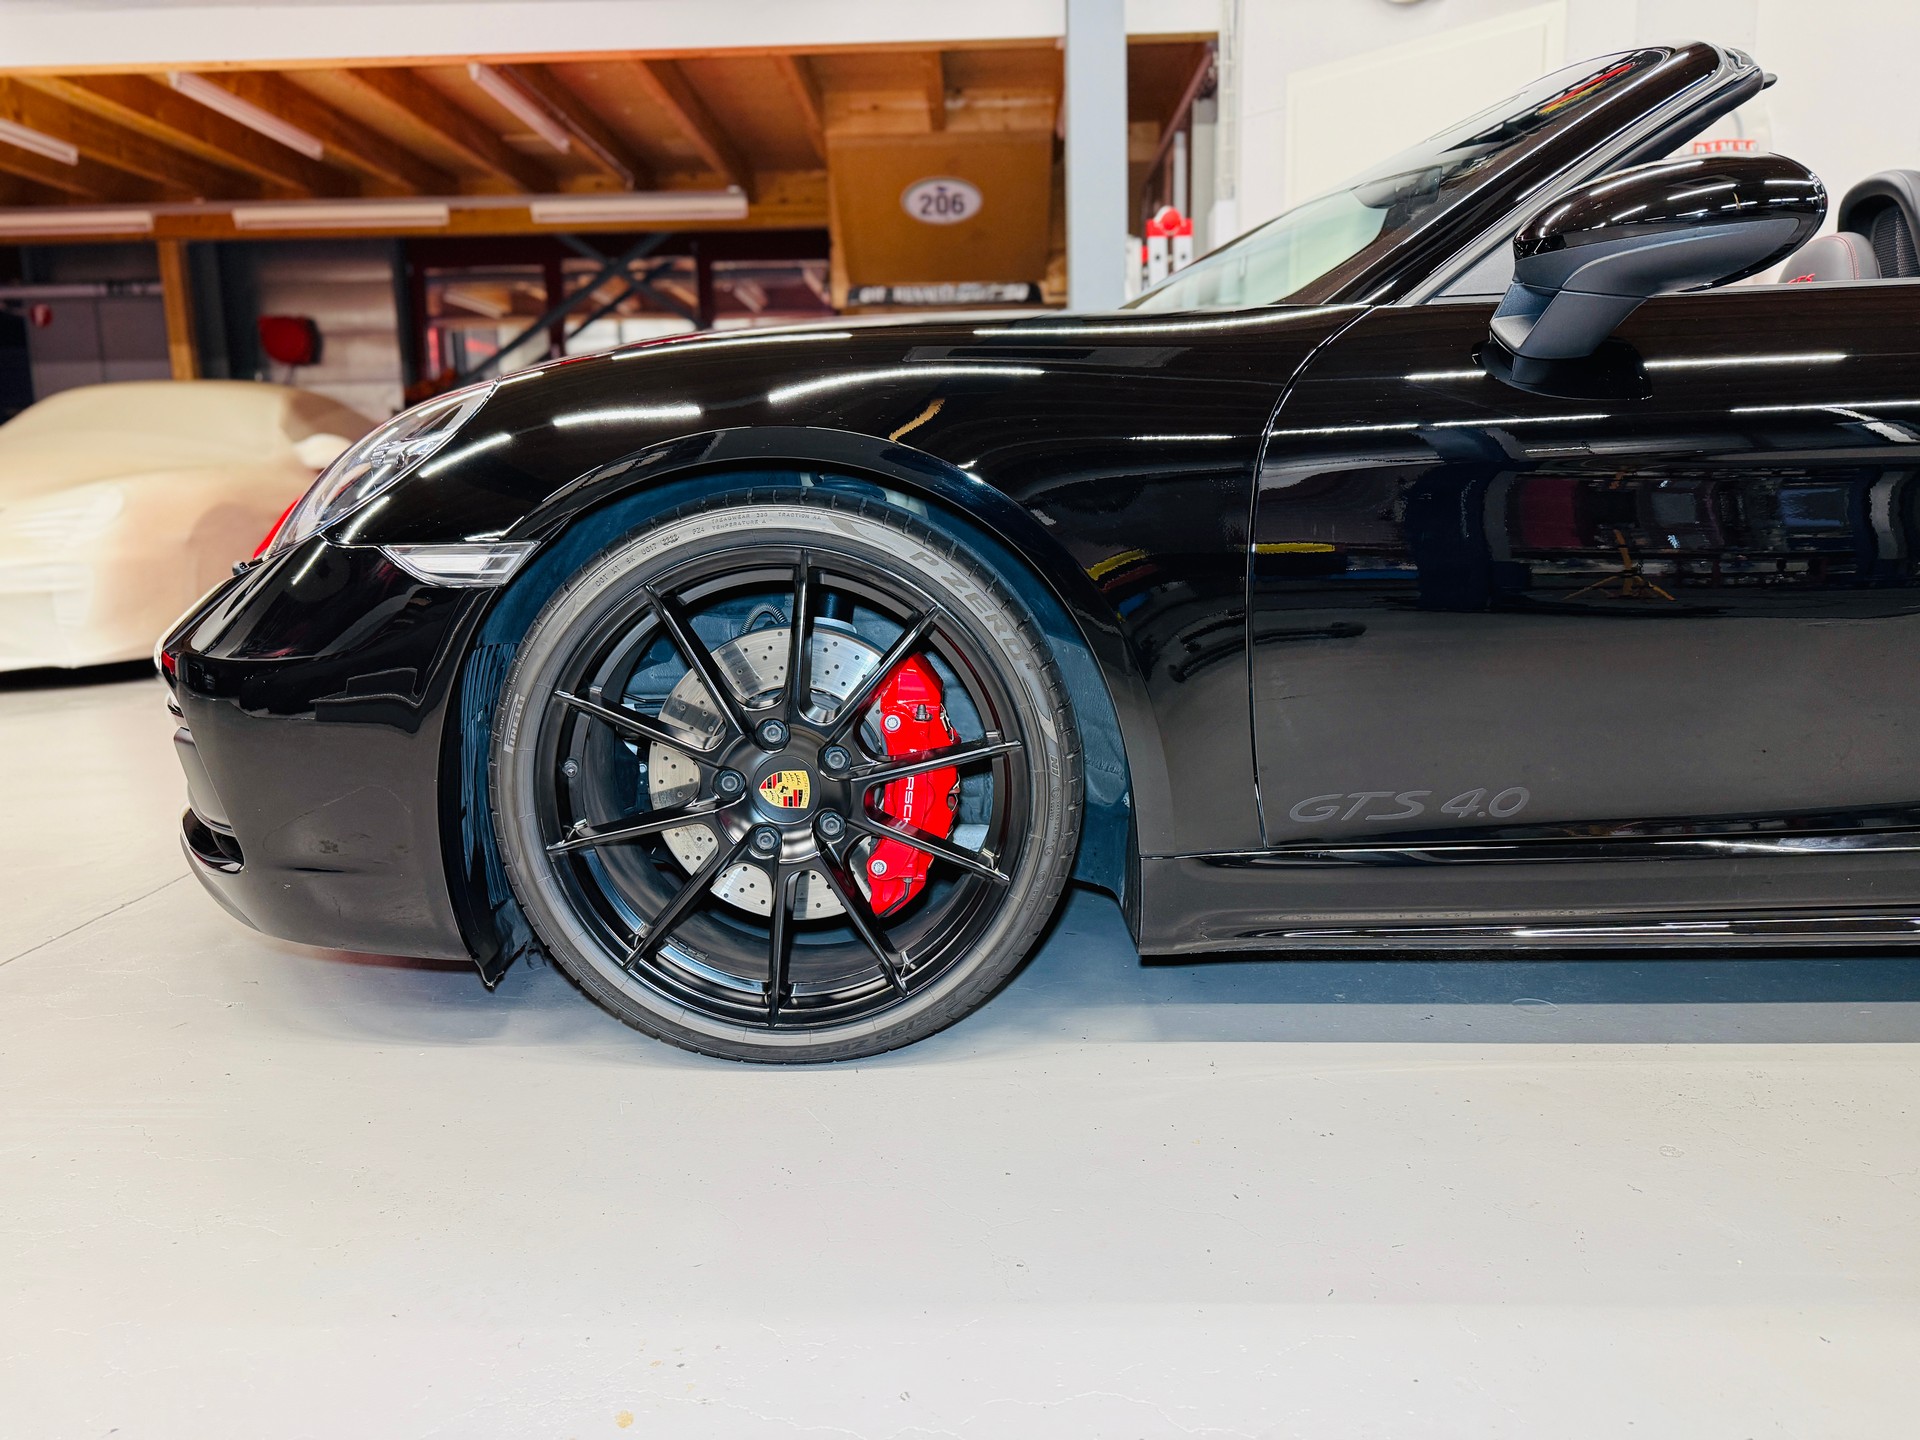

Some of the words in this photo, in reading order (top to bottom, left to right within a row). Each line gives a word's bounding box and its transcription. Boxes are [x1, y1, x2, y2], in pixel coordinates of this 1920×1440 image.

[919, 193, 965, 215] 206
[910, 551, 939, 567] P
[941, 571, 1021, 660] ZERO
[503, 693, 526, 754] PIRELLI
[1289, 790, 1433, 823] GTS
[1440, 786, 1531, 819] 4.0
